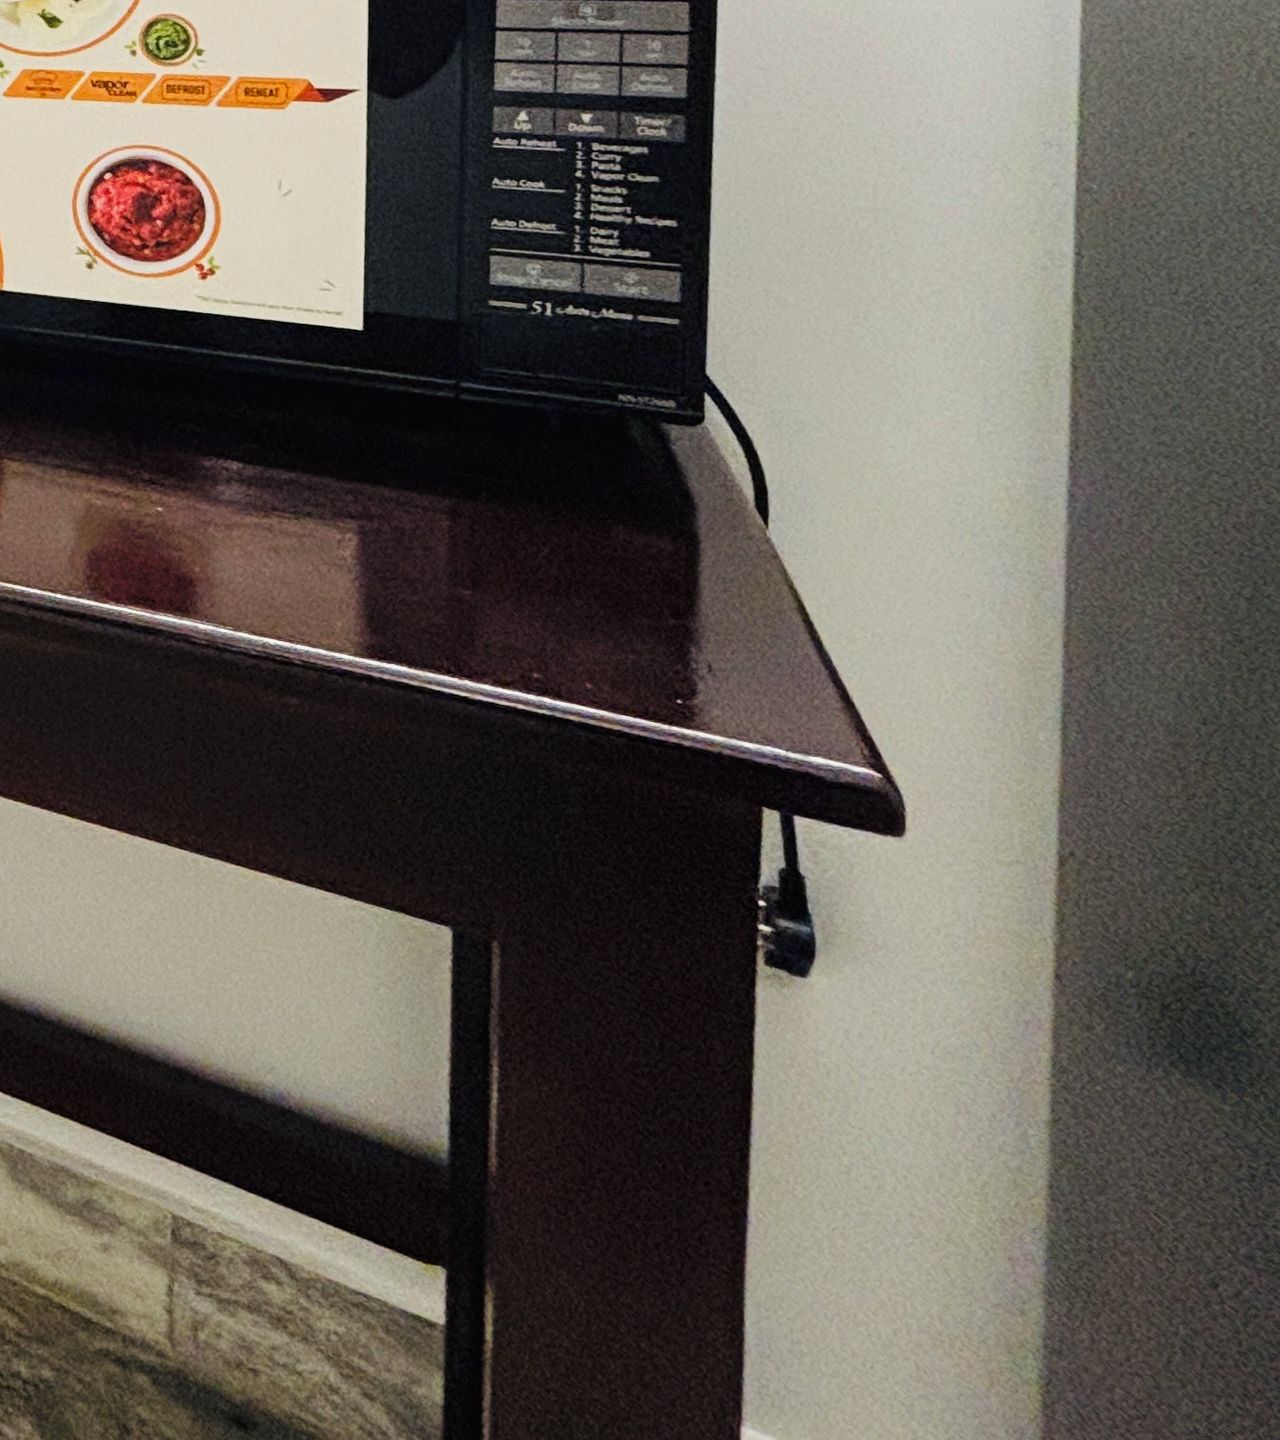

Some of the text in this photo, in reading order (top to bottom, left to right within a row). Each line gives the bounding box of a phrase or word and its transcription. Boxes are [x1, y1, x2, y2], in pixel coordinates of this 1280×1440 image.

[90, 80, 130, 91] vapor
[166, 84, 205, 95] DEFROST
[244, 87, 279, 97] REHEAT
[568, 122, 606, 133] Down
[493, 137, 558, 148] Auto Reheat
[591, 143, 649, 155] Beverages
[591, 152, 622, 162] Curry
[492, 177, 545, 189] Auto Cook
[591, 184, 628, 195] Snacks
[491, 218, 558, 231] Auto Defrost
[531, 301, 553, 317] 51
